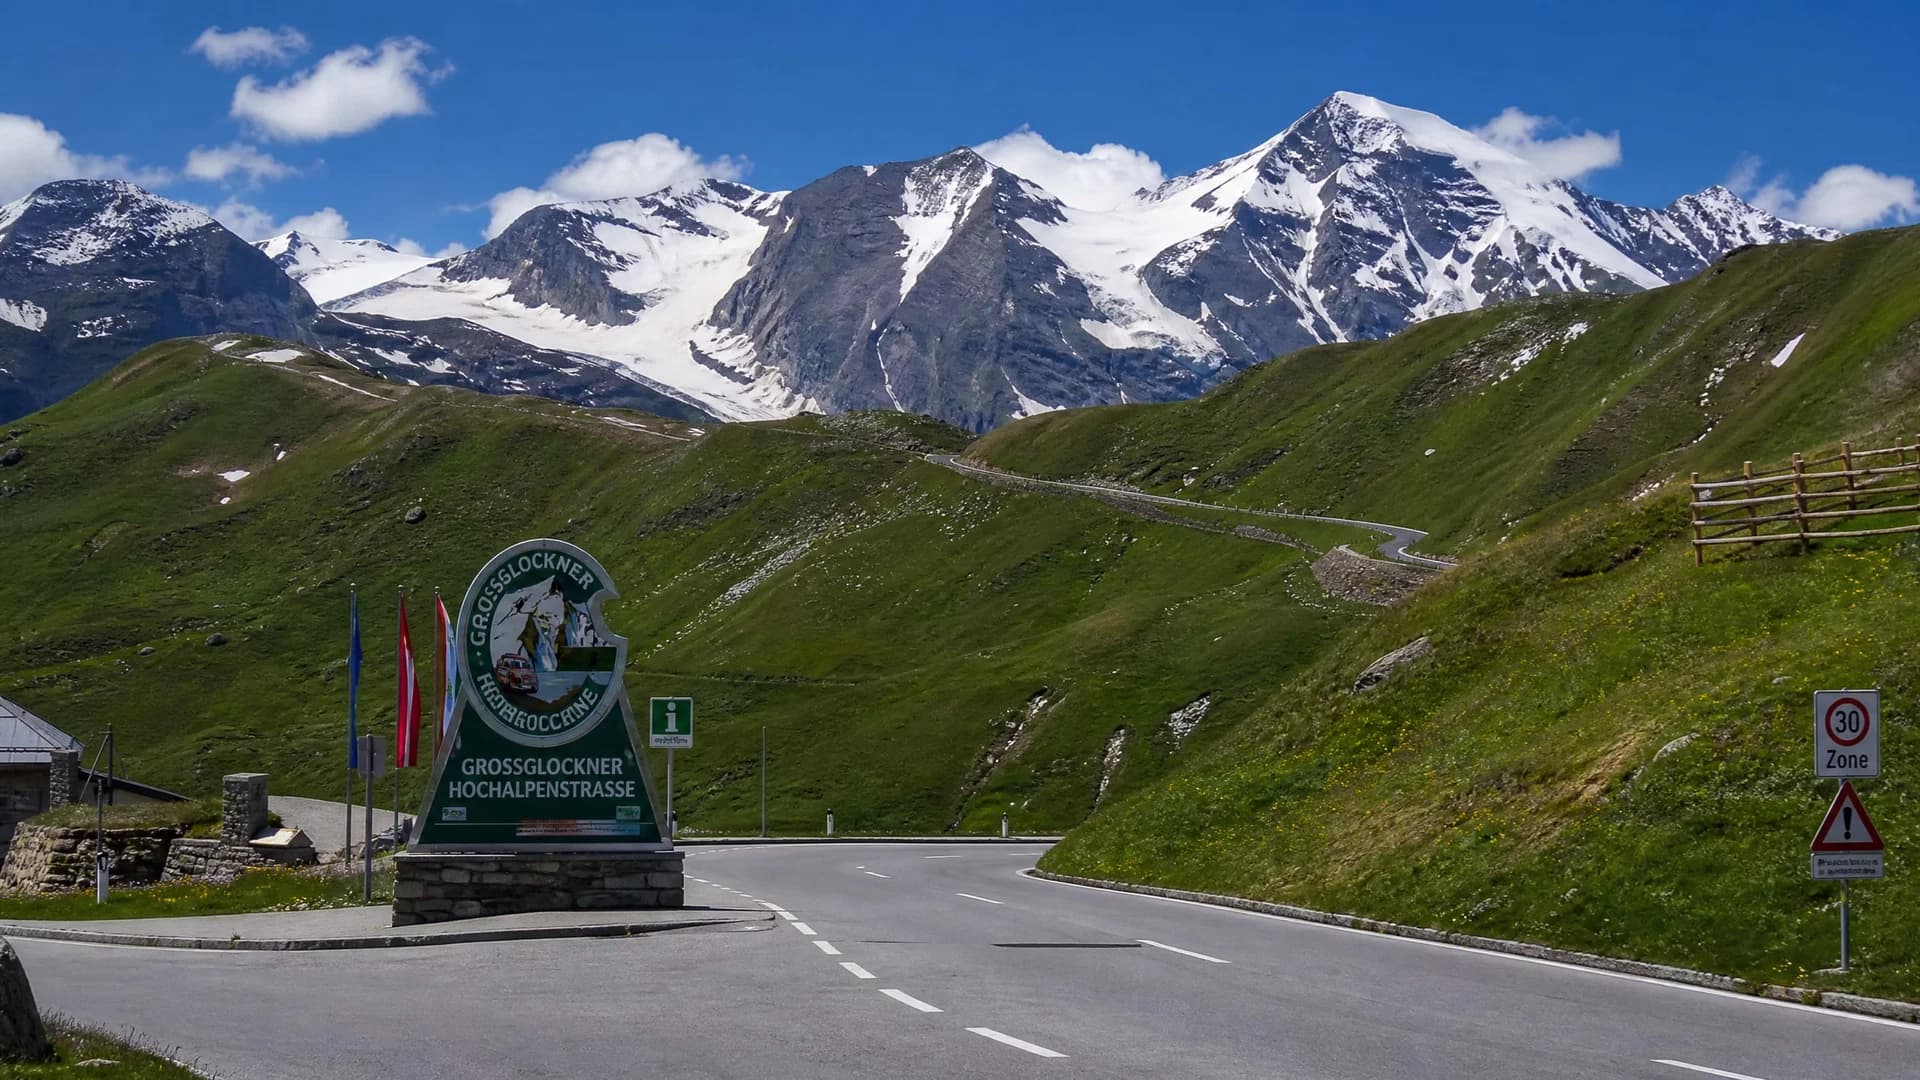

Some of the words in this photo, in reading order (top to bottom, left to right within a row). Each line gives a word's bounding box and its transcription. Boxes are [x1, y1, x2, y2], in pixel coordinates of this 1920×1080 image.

[470, 552, 595, 647] GROSSGLOCKNER
[1835, 710, 1859, 733] 30
[461, 757, 623, 776] GROSSGLOCKNER
[1826, 750, 1868, 769] Zone
[448, 780, 636, 799] HOCHALPENSTRASSE
